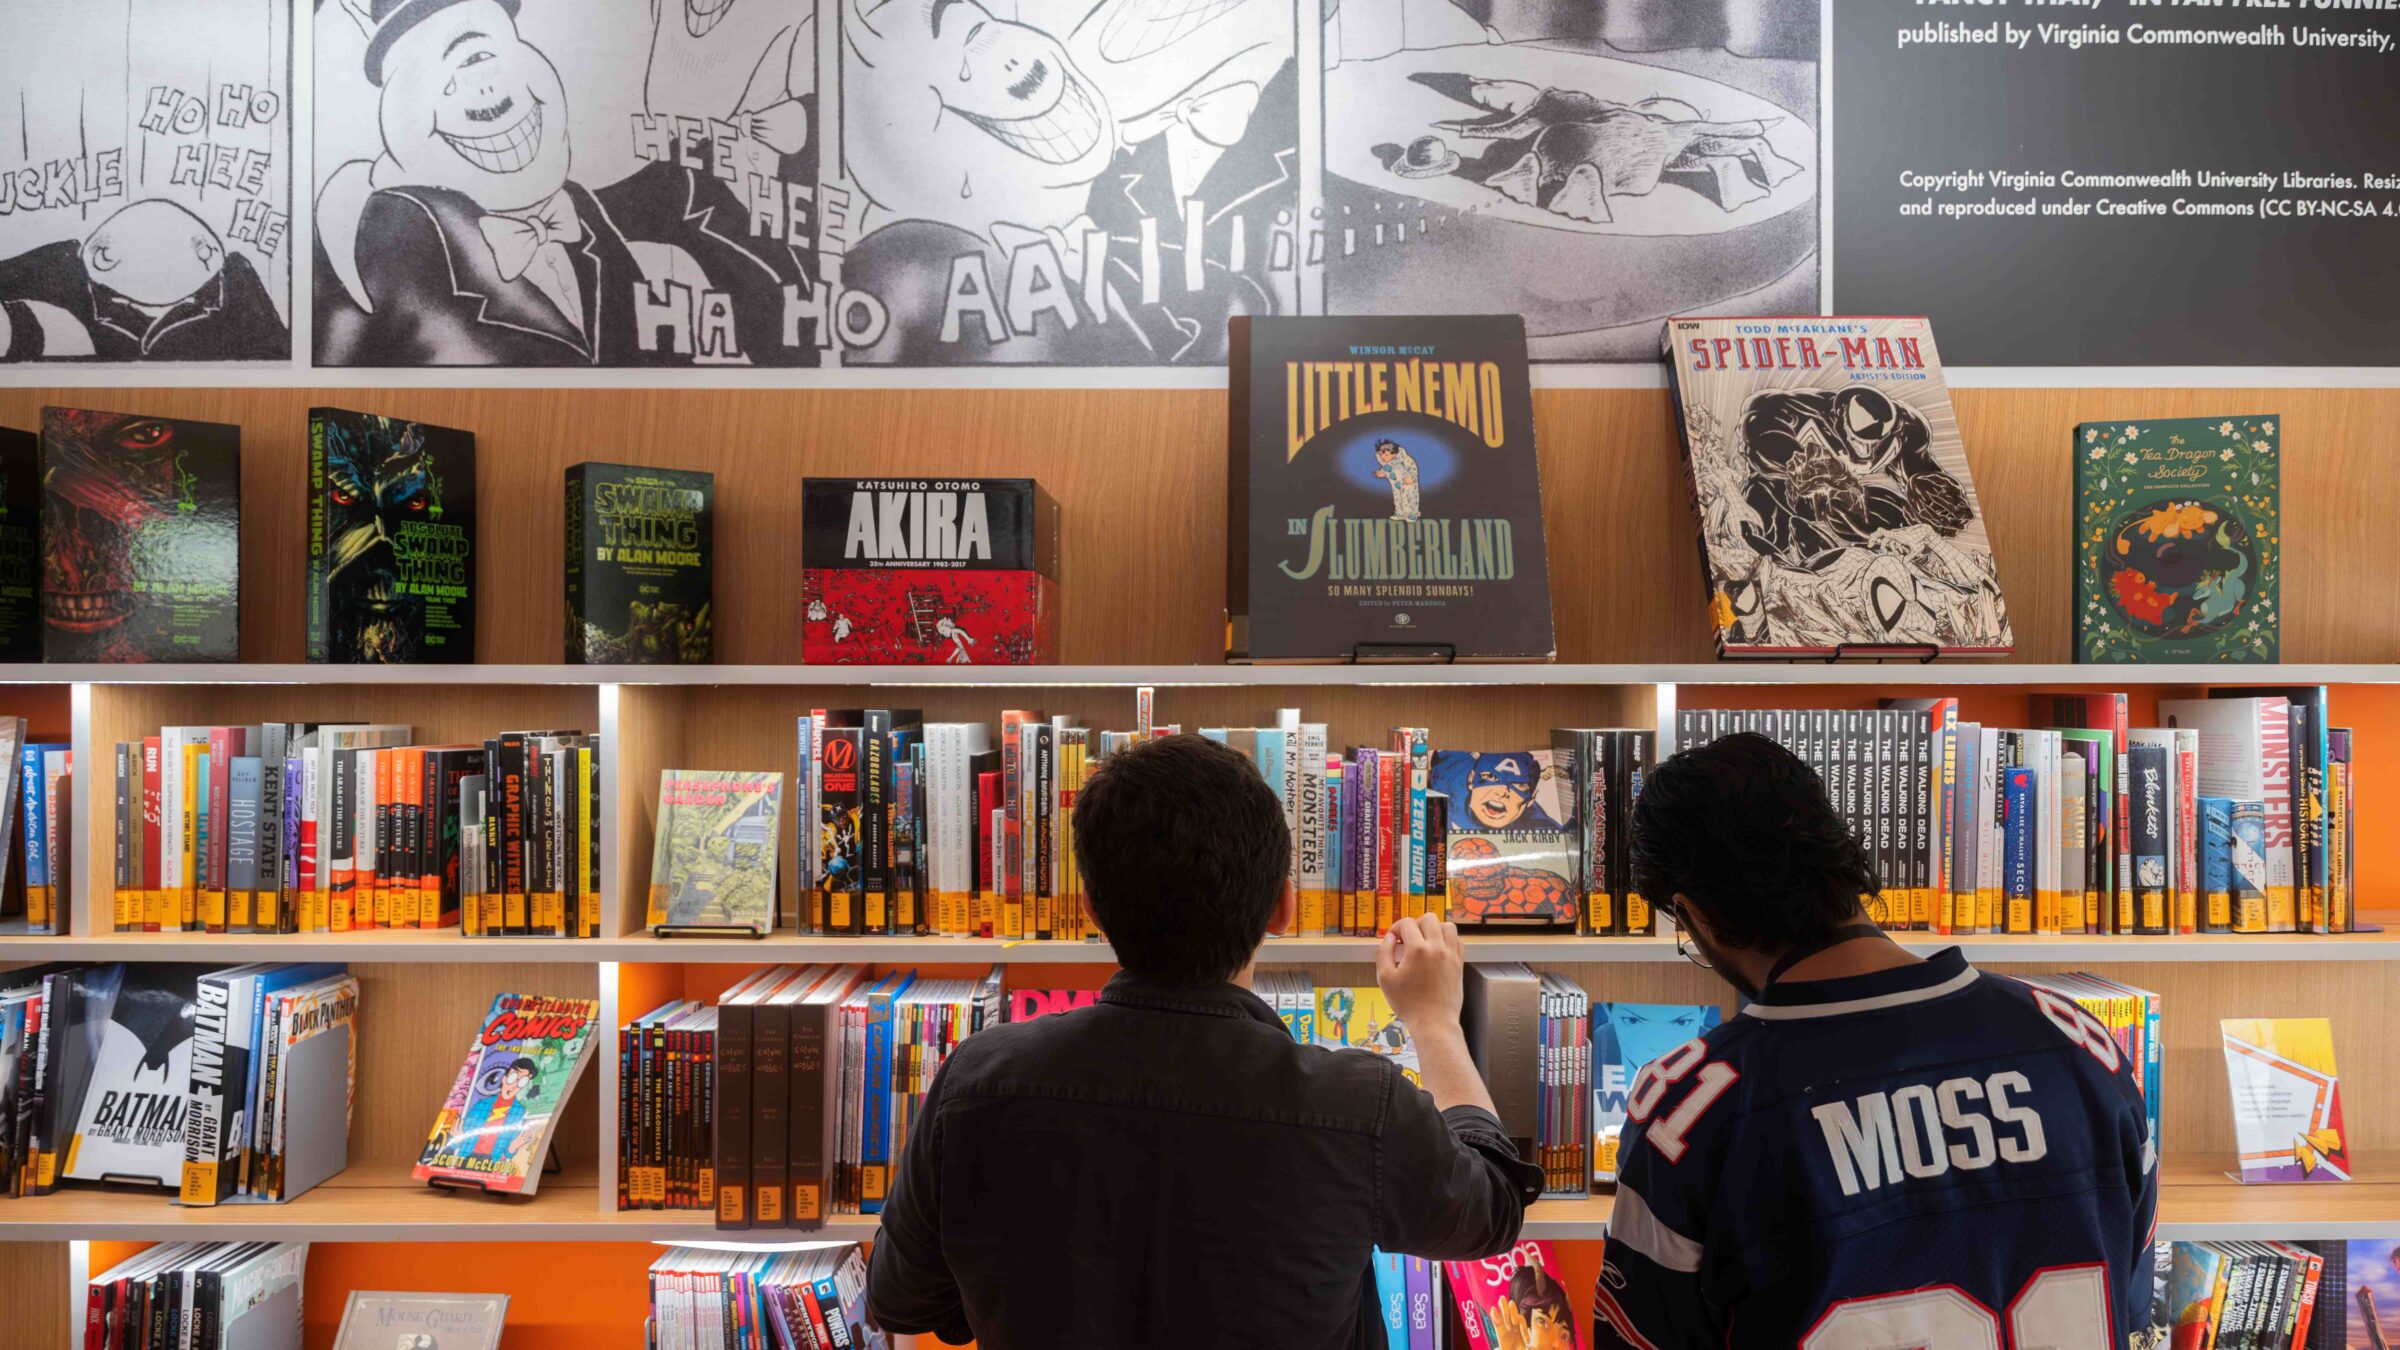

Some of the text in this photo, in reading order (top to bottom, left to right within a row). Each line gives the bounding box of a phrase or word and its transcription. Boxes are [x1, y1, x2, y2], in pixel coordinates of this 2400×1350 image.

[1898, 22, 2396, 52] published by Virginia Commonwealth University,
[140, 84, 280, 136] HO HO
[630, 112, 737, 183] HEE
[171, 144, 272, 195] HEE
[1899, 170, 1984, 192] Copyright
[1988, 170, 2055, 192] Virginia
[2060, 169, 2191, 188] Commonwealth
[2197, 171, 2278, 193] University
[2283, 172, 2358, 189] Libraries.
[749, 173, 852, 257] HEE
[1899, 198, 2377, 219] and reproduced under Creative Commons (CC BY-NC-SA
[227, 199, 289, 258] HE
[632, 280, 889, 357] HA HO
[1736, 325, 1868, 334] TODD McFARLANE'S
[1349, 345, 1395, 355] WINSOR
[1689, 337, 1926, 371] SPIDER-MAN
[1286, 356, 1505, 464] LITTLE NEMO
[2140, 448, 2216, 464] Tea Dragon
[2147, 464, 2208, 482] Society
[311, 422, 325, 556] SWAMP THING
[595, 482, 704, 520] SWAMP
[857, 481, 980, 490] KATSUHIRO OTOMO
[400, 521, 463, 538] ABSOLUTE
[599, 514, 698, 550] THING
[844, 491, 992, 560] AKIRA
[1278, 505, 1514, 580] IN SLUMBERLAND
[393, 532, 470, 560] SWAMP
[596, 547, 701, 566] BY ALAN MOORE
[396, 557, 466, 584] THING
[395, 583, 468, 598] BY ALAN MOORE
[1328, 585, 1474, 597] SO MANY SPLENDID SUNDAYS!
[146, 747, 158, 773] RUN
[1798, 739, 1807, 760] THE
[1814, 739, 1823, 761] THE
[1831, 739, 1840, 760] THE
[1944, 711, 1957, 785] EX LIBRIS
[336, 776, 344, 795] ARAB
[663, 779, 775, 794] PERSEPHONE'S
[824, 783, 856, 792] ONE
[869, 739, 880, 804] RAZORBLADES
[1285, 732, 1296, 815] Kill My Mother
[1847, 739, 1857, 814] THE WALKING
[2259, 697, 2293, 849] MONSTERS
[336, 796, 343, 804] OF
[505, 774, 521, 837] GRAPHIC
[663, 794, 727, 806] GARDEN
[1863, 740, 1873, 849] THE WALKING DEAD
[1881, 739, 1891, 848] THE WALKING DEAD
[1898, 740, 1908, 849] THE WALKING DEAD
[1917, 740, 1927, 849] THE WALKING DEAD
[2144, 767, 2161, 839] Blankets
[230, 799, 256, 865] HOSTAGE
[261, 766, 280, 880] KENT STATE
[1303, 773, 1317, 874] MONSTERS
[1503, 833, 1562, 844] JACK KIRBY
[2075, 796, 2084, 849] SAILOR
[1411, 799, 1425, 886] ZERO HOUR
[1363, 848, 1371, 889] HORSEBACK
[1428, 854, 1436, 888] ROBOT
[1436, 843, 1444, 886] MONKEY
[254, 982, 262, 1014] BATMAN
[291, 995, 358, 1037] BLACK PANTHER
[500, 996, 591, 1017] UNDERSTANDING
[190, 979, 230, 1086] BATMAN
[481, 1011, 586, 1047] COMICS
[870, 1024, 884, 1157] CAPTAIN AMERICA
[1626, 1036, 1741, 1166] 81
[185, 1099, 204, 1165] MORRISON
[201, 1103, 218, 1158] BY GRANT
[1811, 1070, 2047, 1197] MOSS
[432, 1153, 516, 1175] SCOTT McCLOUD
[1480, 1241, 1546, 1287] Saga
[1390, 1292, 1404, 1329] Saga
[1414, 1292, 1429, 1330] Saga
[2267, 1269, 2290, 1332] SWAMP THING
[2301, 1280, 2317, 1306] TORSO
[90, 1306, 100, 1324] JINX
[153, 1310, 163, 1338] LOCKE
[170, 1308, 179, 1336] LOCKE
[181, 1309, 190, 1338] LOCKE
[825, 1306, 850, 1349] POWERS
[1461, 1299, 1480, 1339] Saga
